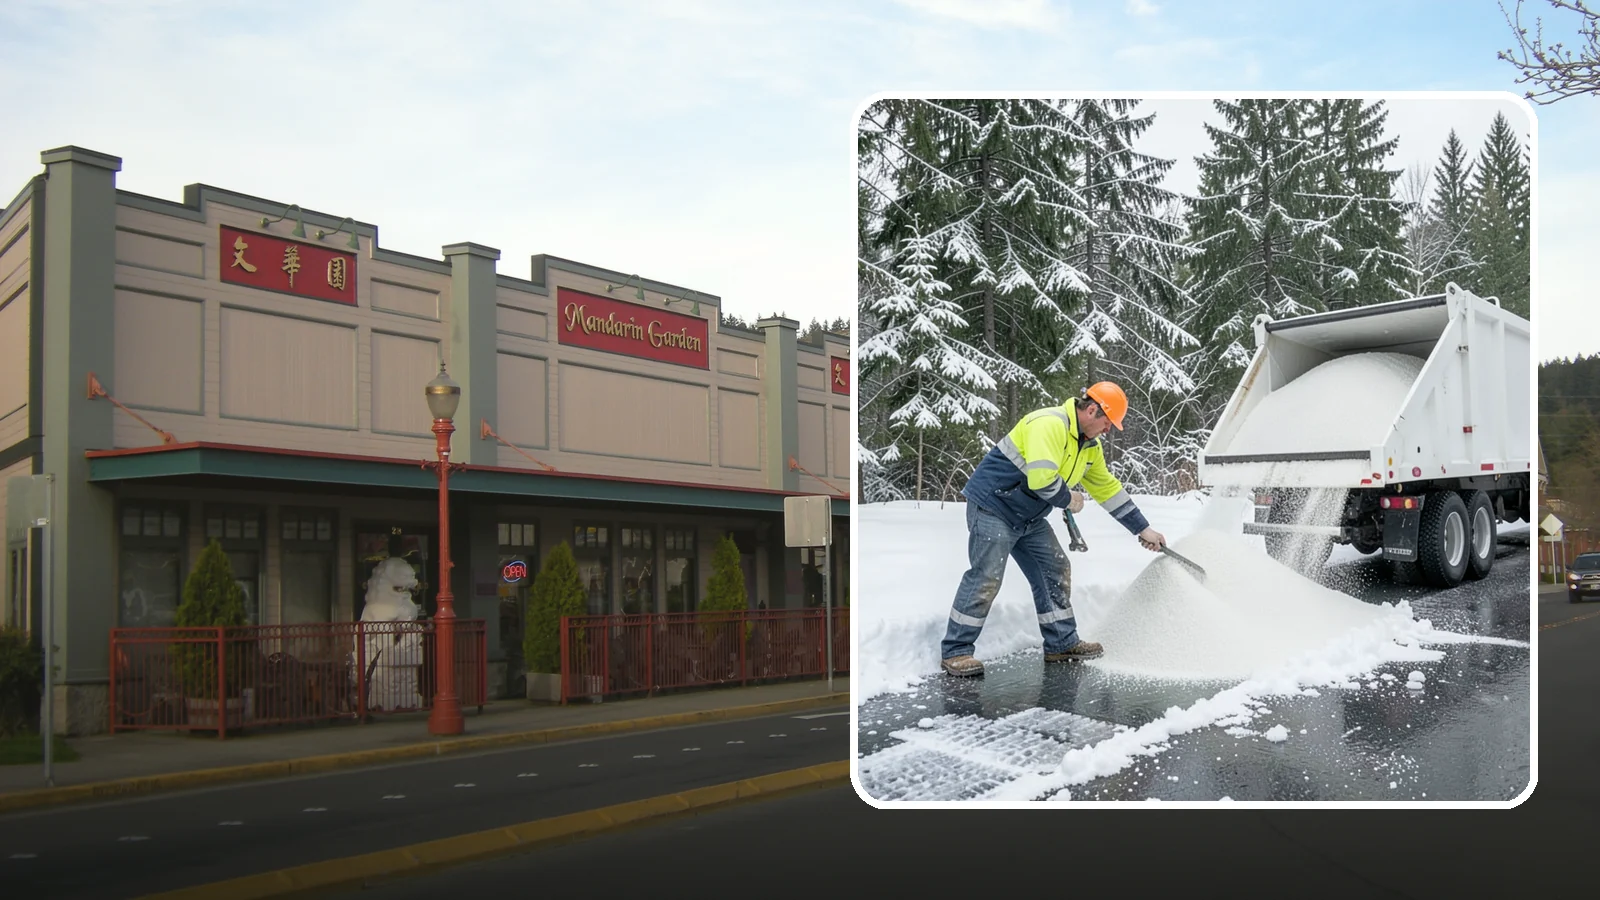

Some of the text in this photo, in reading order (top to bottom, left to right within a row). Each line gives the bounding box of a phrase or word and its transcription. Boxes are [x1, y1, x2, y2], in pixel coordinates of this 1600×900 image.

[564, 302, 701, 352] Mandarin Garden
[503, 565, 527, 578] OPEN
